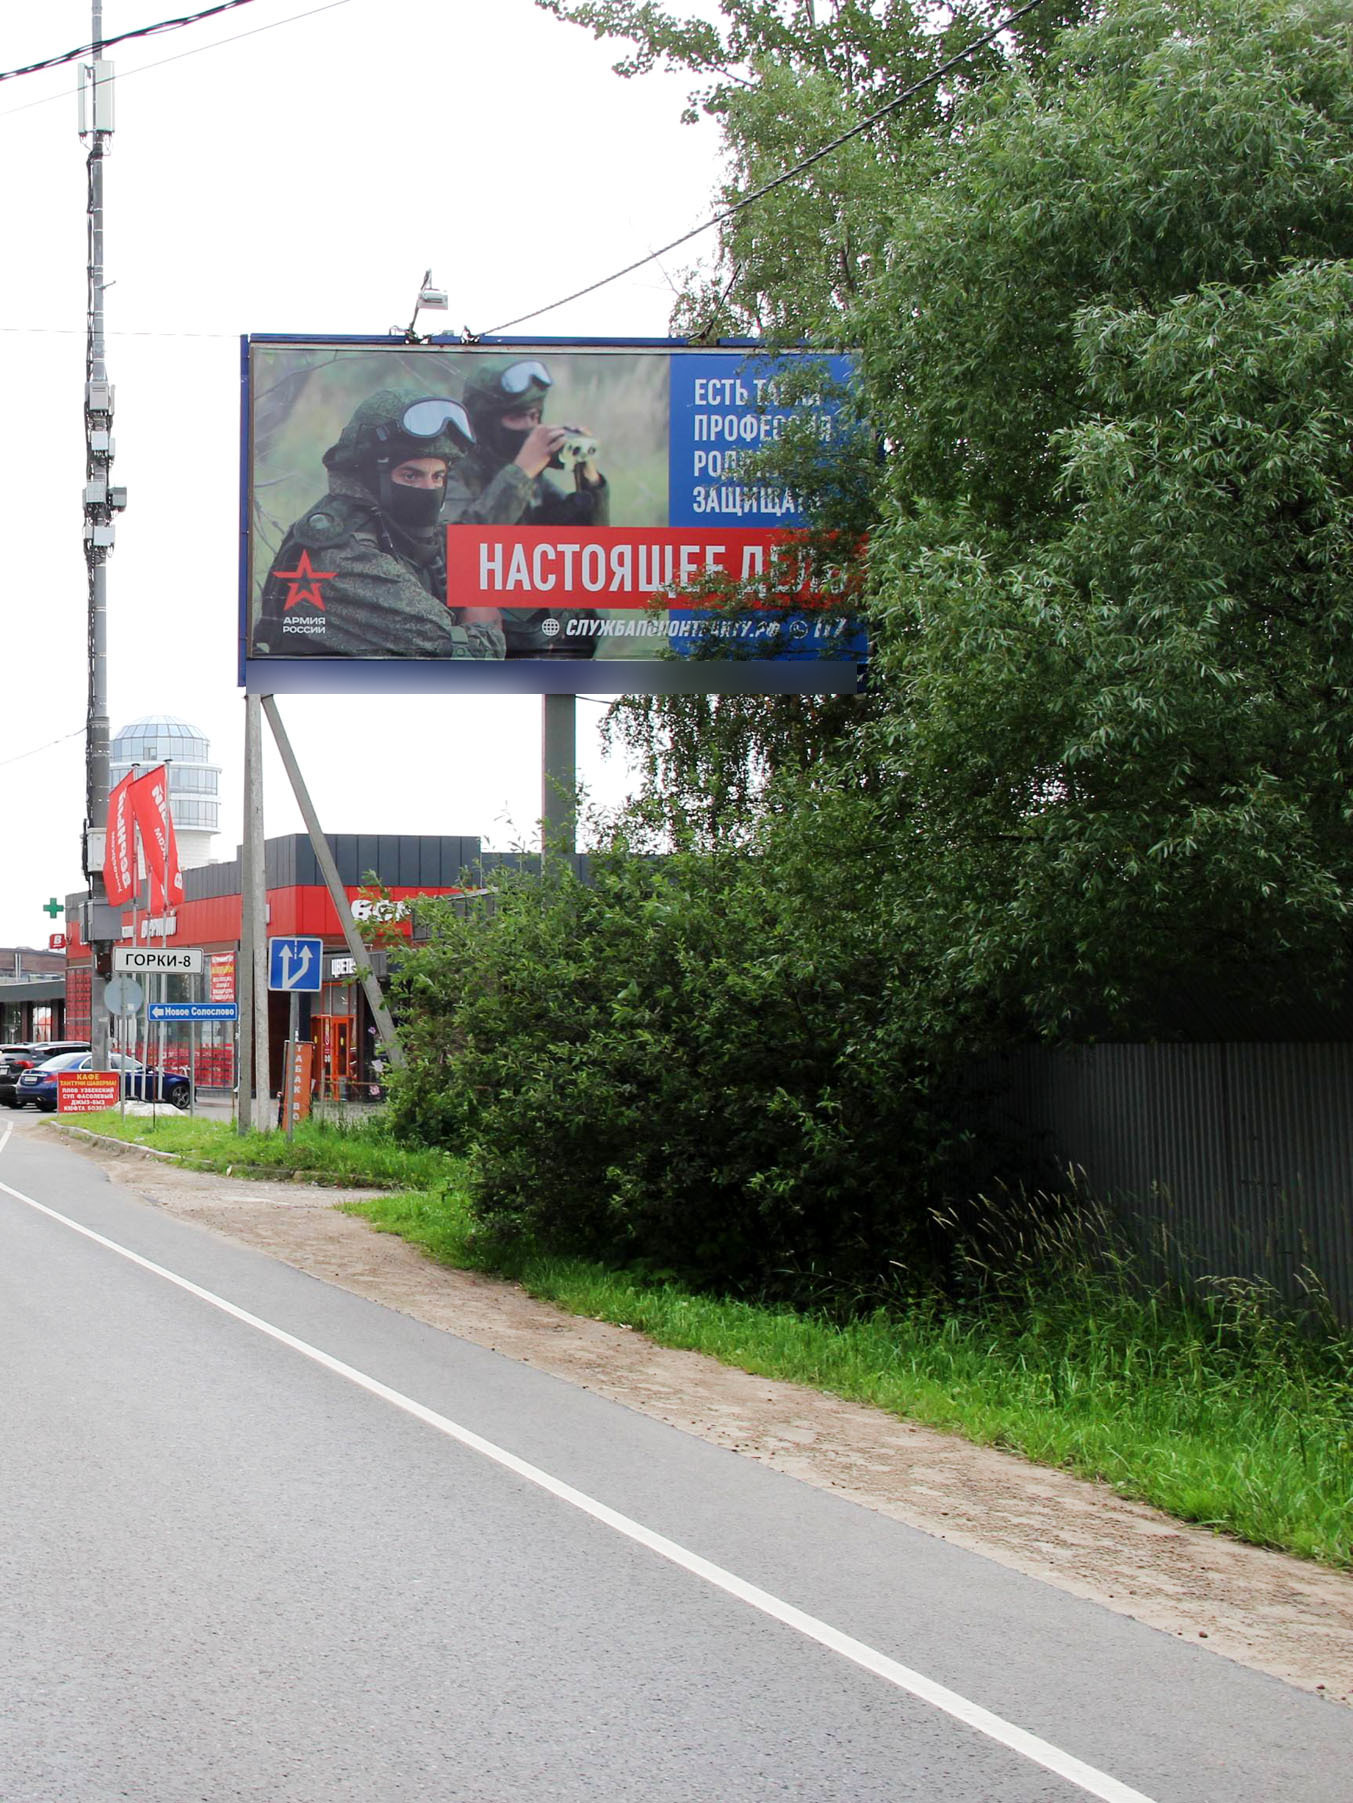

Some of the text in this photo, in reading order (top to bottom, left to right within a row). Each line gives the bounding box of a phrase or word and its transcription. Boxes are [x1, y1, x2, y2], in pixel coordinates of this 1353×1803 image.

[694, 378, 748, 405] ЕСТЬ
[692, 486, 822, 517] ЗАЩИЩА
[479, 542, 727, 599] НАСТОЯЩЕЕ
[282, 625, 325, 634] РОССИИ
[283, 616, 325, 625] АРМИЯ
[125, 953, 191, 967] ГОРКИ-8
[165, 1006, 234, 1017] Новое Солослово
[293, 1044, 303, 1094] ТАБАК
